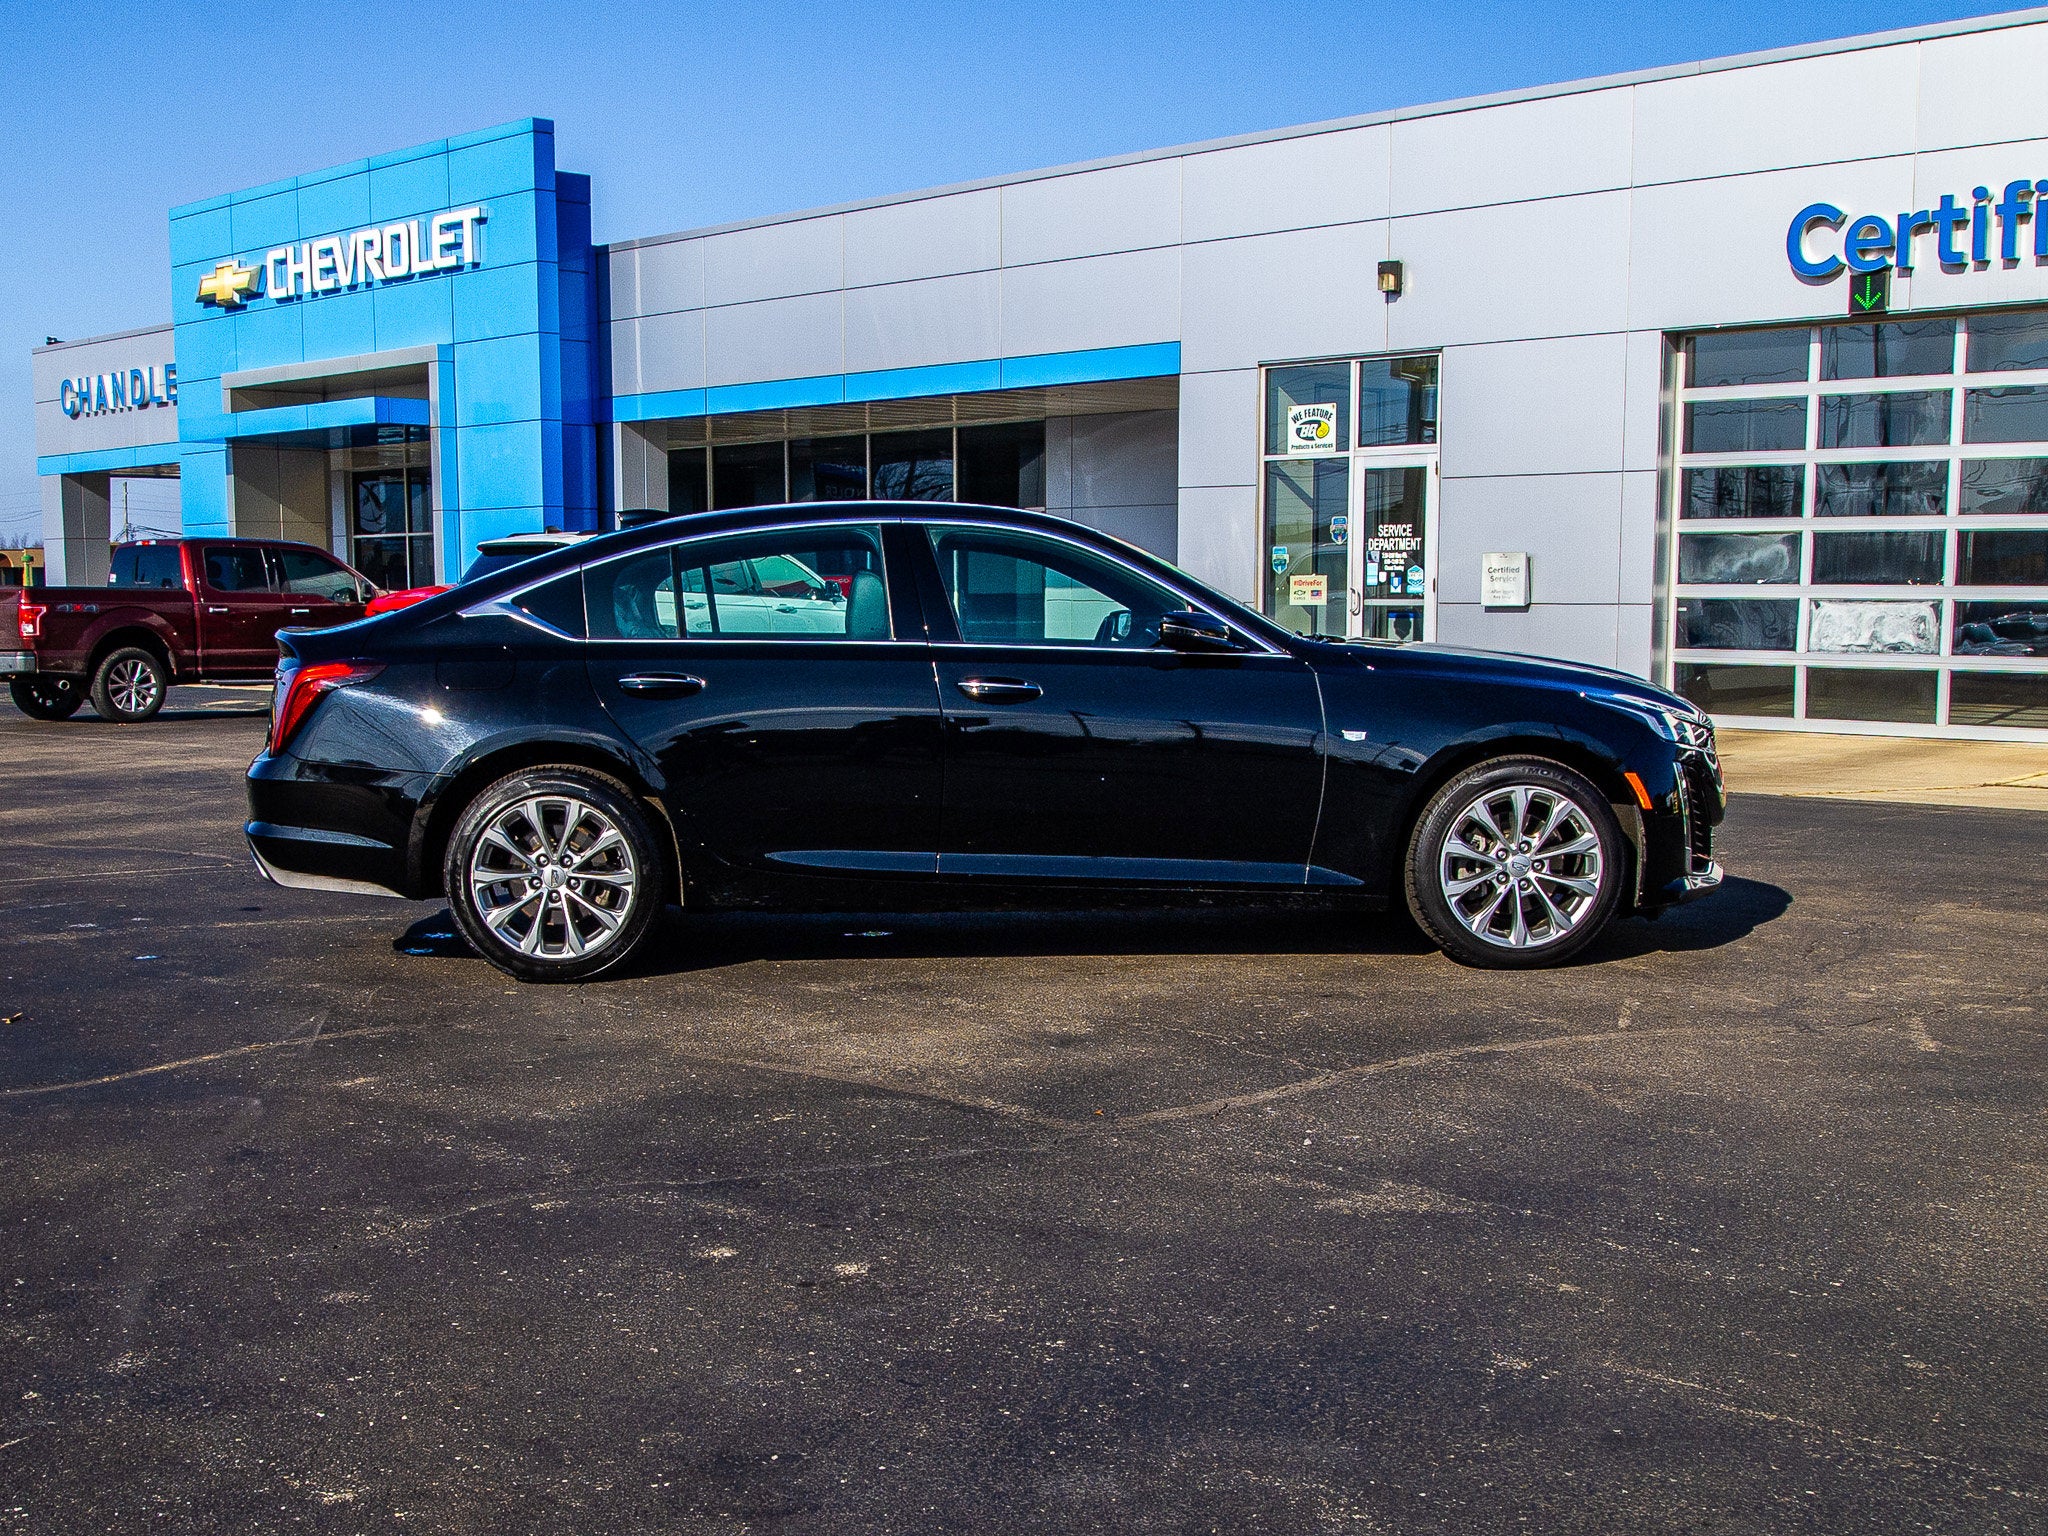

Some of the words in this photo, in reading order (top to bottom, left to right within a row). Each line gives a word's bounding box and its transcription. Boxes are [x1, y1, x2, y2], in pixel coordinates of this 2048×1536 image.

[1787, 179, 2048, 276] Certifi
[266, 206, 481, 299] CHEVROLET
[61, 363, 178, 417] CHANDLE
[1291, 411, 1303, 424] WE
[1304, 408, 1333, 421] FEATURE
[1378, 524, 1413, 537] SERVICE
[1368, 538, 1422, 551] DEPARTMENT
[1487, 566, 1520, 574] Certified
[1490, 575, 1518, 583] Service
